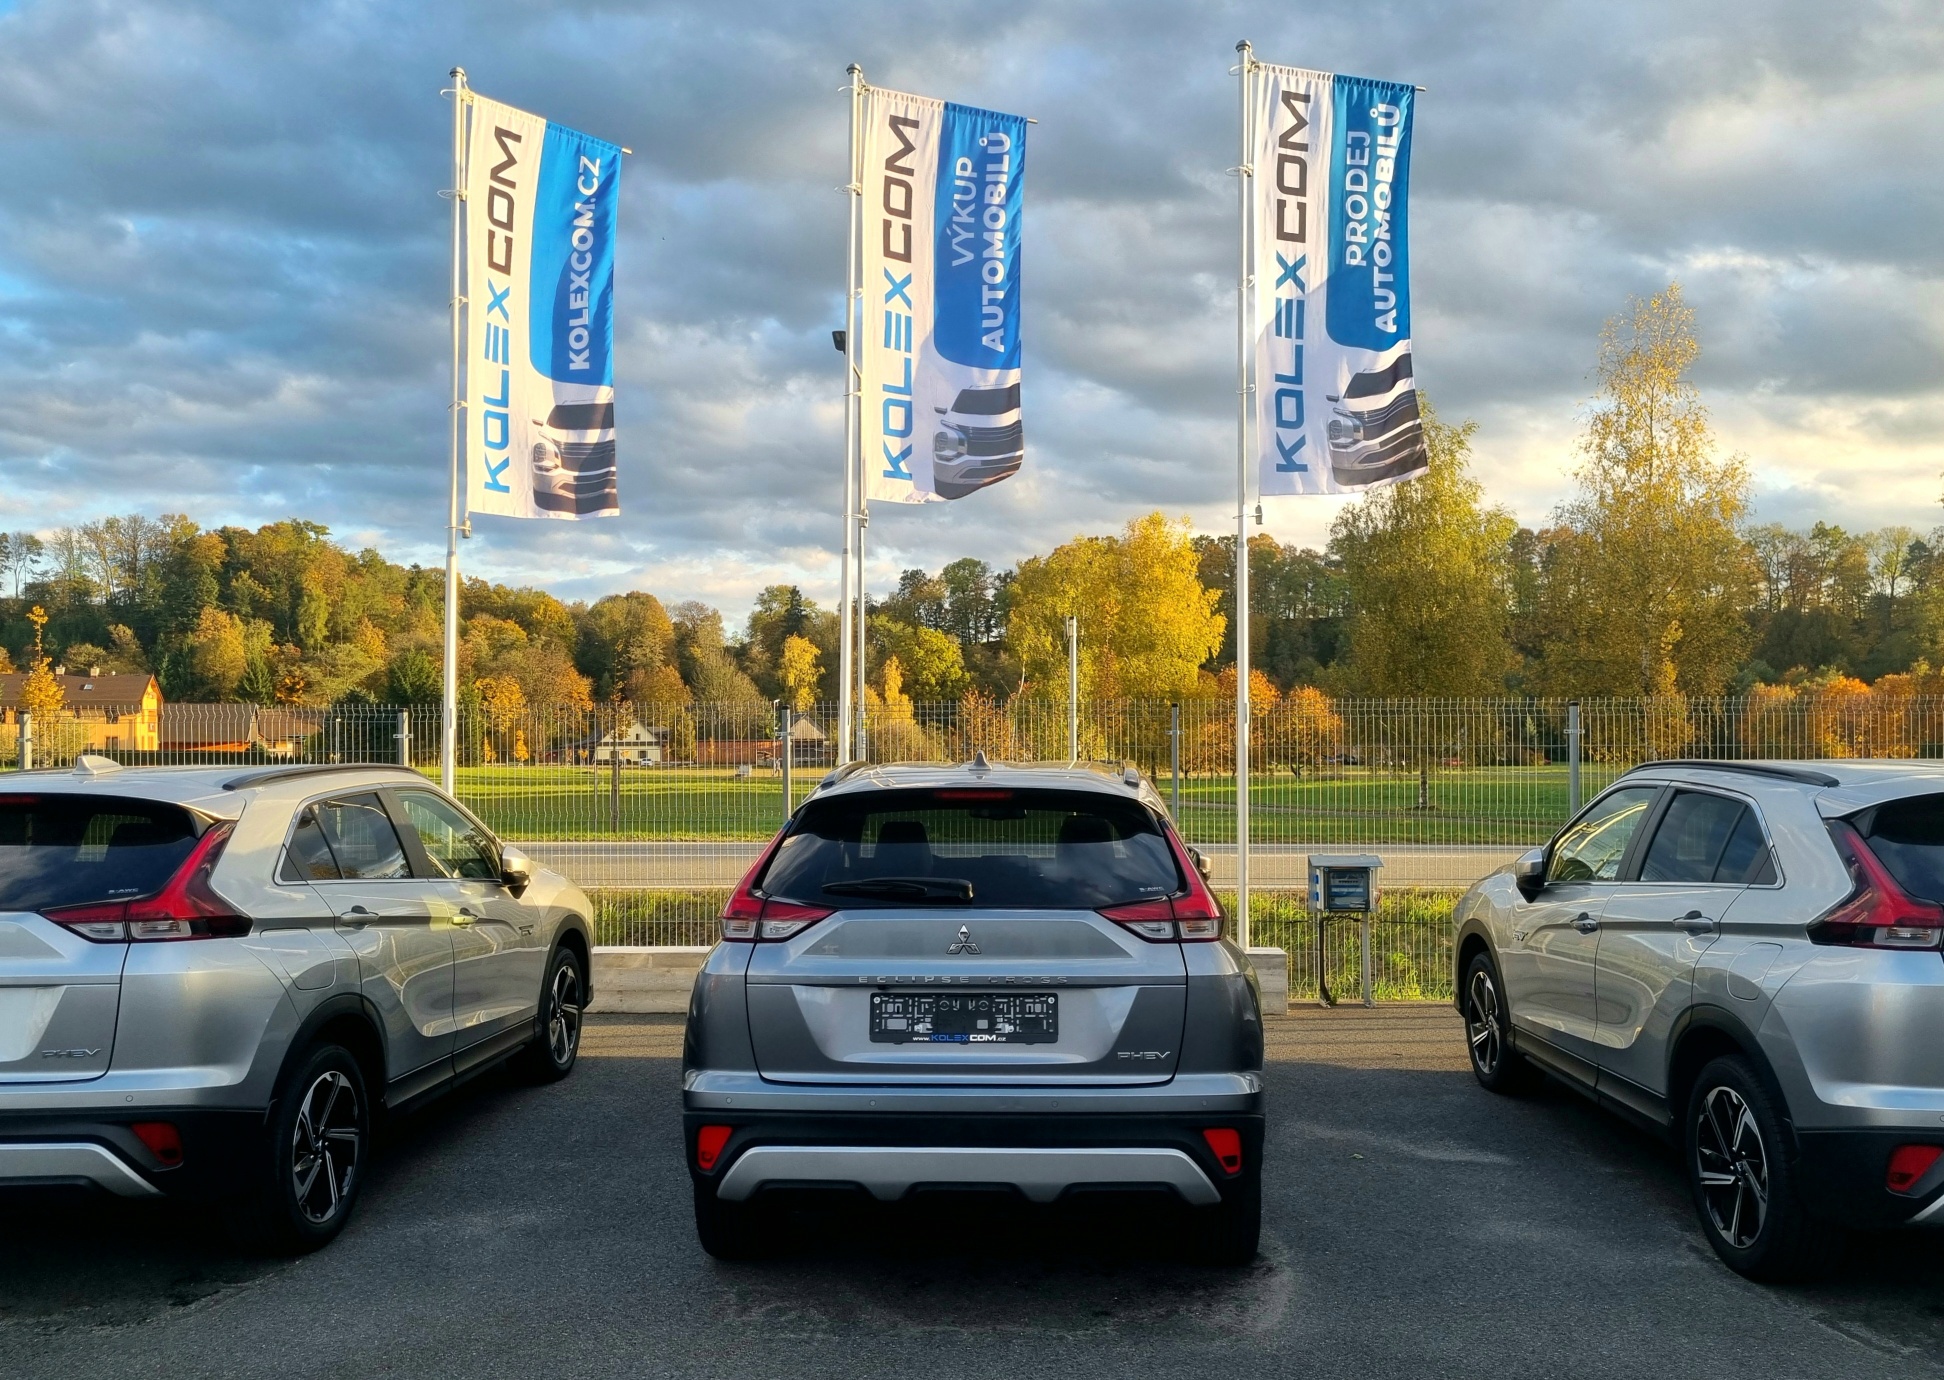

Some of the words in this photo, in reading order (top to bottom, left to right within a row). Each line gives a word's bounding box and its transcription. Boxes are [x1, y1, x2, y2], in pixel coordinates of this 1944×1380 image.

[569, 155, 600, 371] KOLEXCOM.CZ
[883, 114, 920, 480] KOLEXCOM
[952, 156, 978, 267] VÝKUP
[979, 131, 1011, 353] AUTOMOBILŮ
[1276, 90, 1311, 473] KOLEXCOM
[1346, 131, 1371, 267] PRODEJ
[1370, 102, 1400, 333] AUTOMOBILŮ
[483, 125, 522, 493] KOLEXCOM
[41, 1048, 101, 1059] PHEV
[858, 976, 970, 984] ECLIPSE
[988, 976, 1068, 984] CROSS
[1117, 1051, 1171, 1060] PHEV
